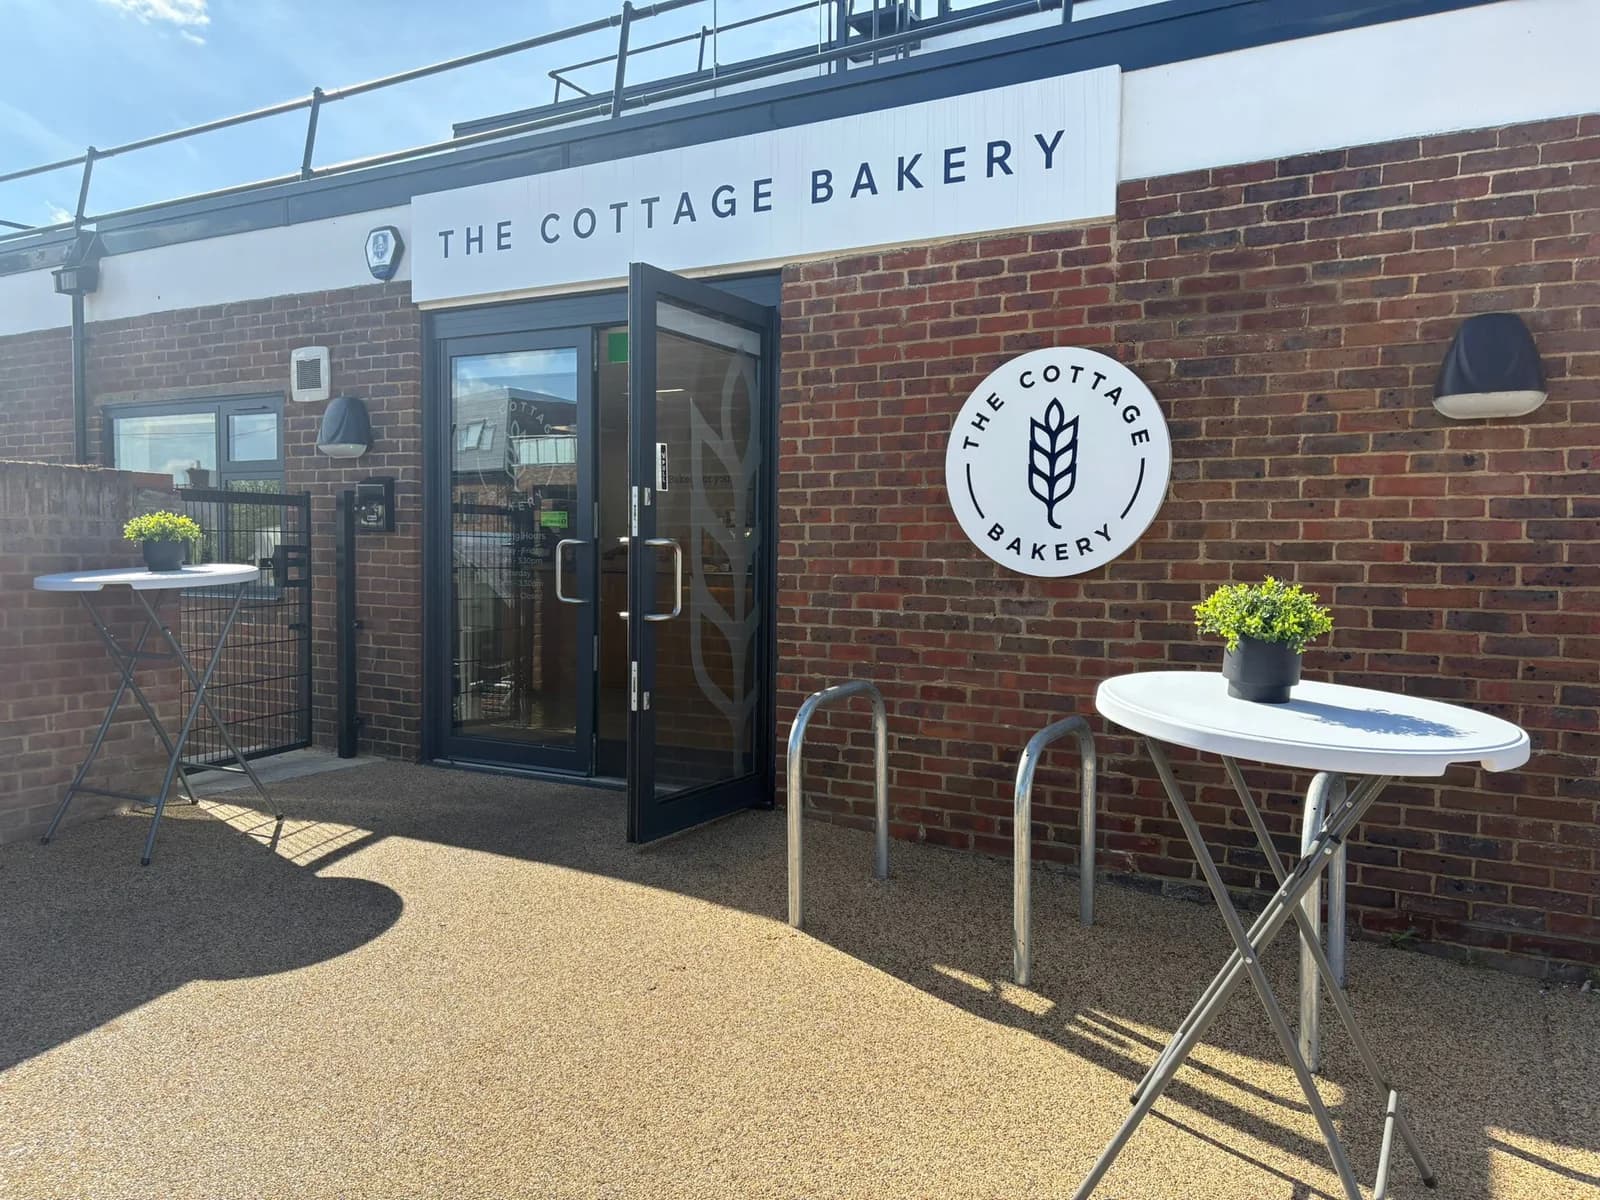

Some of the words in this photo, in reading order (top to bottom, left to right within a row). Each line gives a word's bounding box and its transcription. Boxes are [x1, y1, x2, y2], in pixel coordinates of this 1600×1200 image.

[438, 221, 512, 259] THE
[540, 178, 773, 244] COTTAGE
[811, 130, 1066, 204] BAKERY
[499, 401, 557, 439] COTTAG
[963, 392, 1005, 450] THE
[1019, 365, 1151, 447] COTTAGE
[987, 523, 1112, 561] BAKERY
